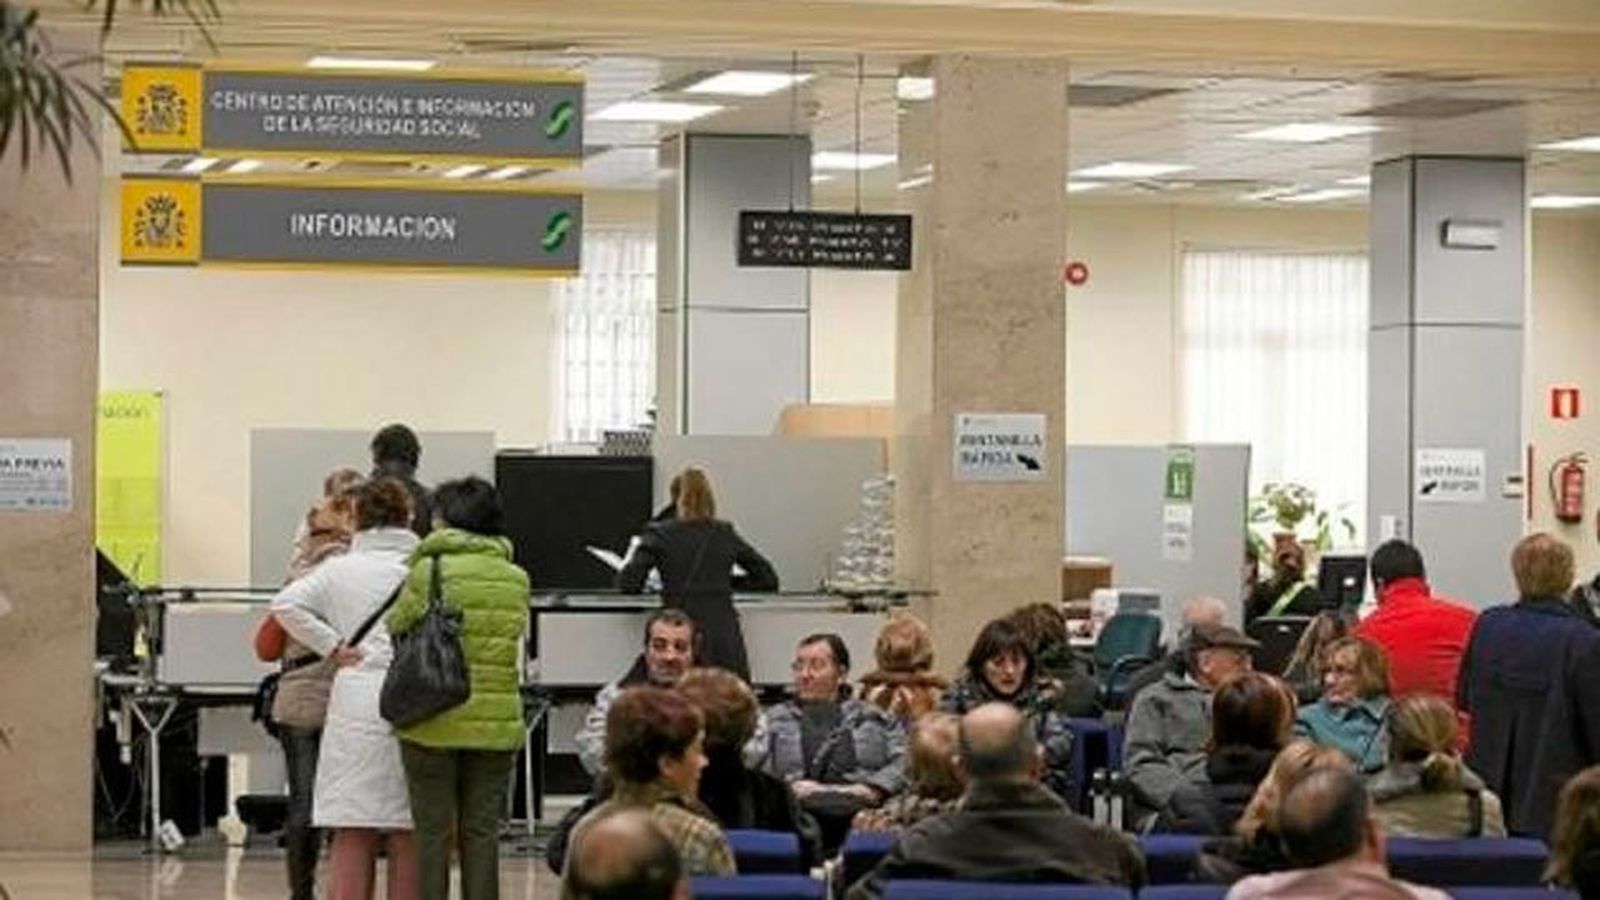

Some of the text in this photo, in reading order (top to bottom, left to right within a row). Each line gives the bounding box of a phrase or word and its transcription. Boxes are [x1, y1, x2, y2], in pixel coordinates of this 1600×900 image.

[213, 90, 281, 111] CENTRO
[286, 94, 310, 111] DE
[263, 115, 481, 139] DE LA SEGURIDAD SOCIAL
